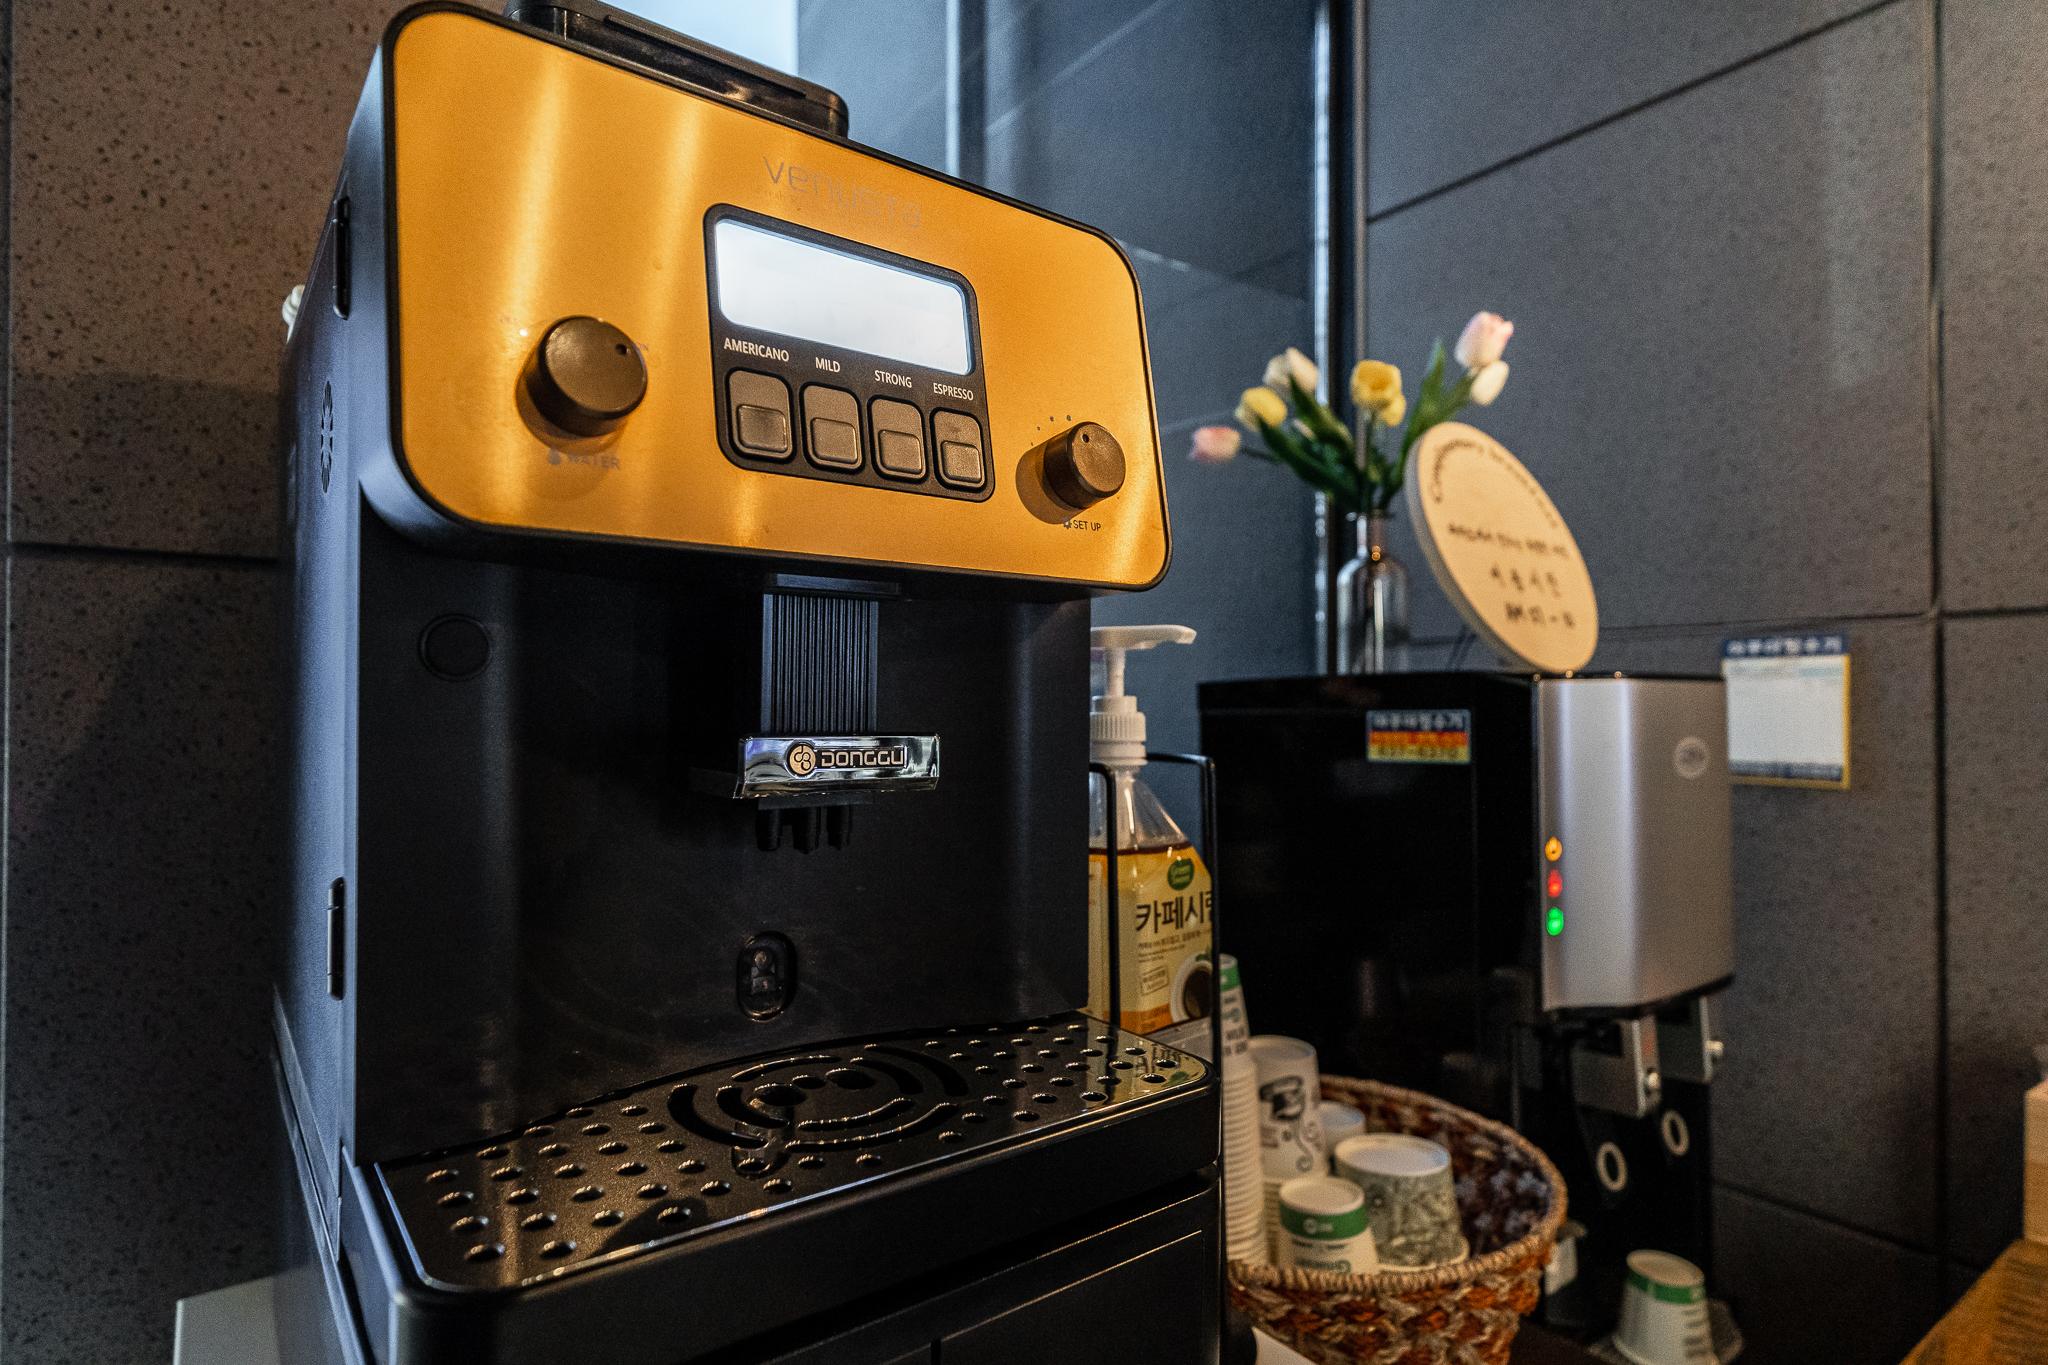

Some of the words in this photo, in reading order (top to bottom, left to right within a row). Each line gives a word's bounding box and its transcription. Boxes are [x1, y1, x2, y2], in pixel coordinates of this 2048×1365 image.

[723, 337, 790, 363] AMERICANO
[815, 357, 841, 373] MILD
[874, 370, 912, 388] STRONG
[933, 382, 974, 401] ESPRESSO
[1073, 519, 1089, 530] SET
[1091, 521, 1101, 531] UP
